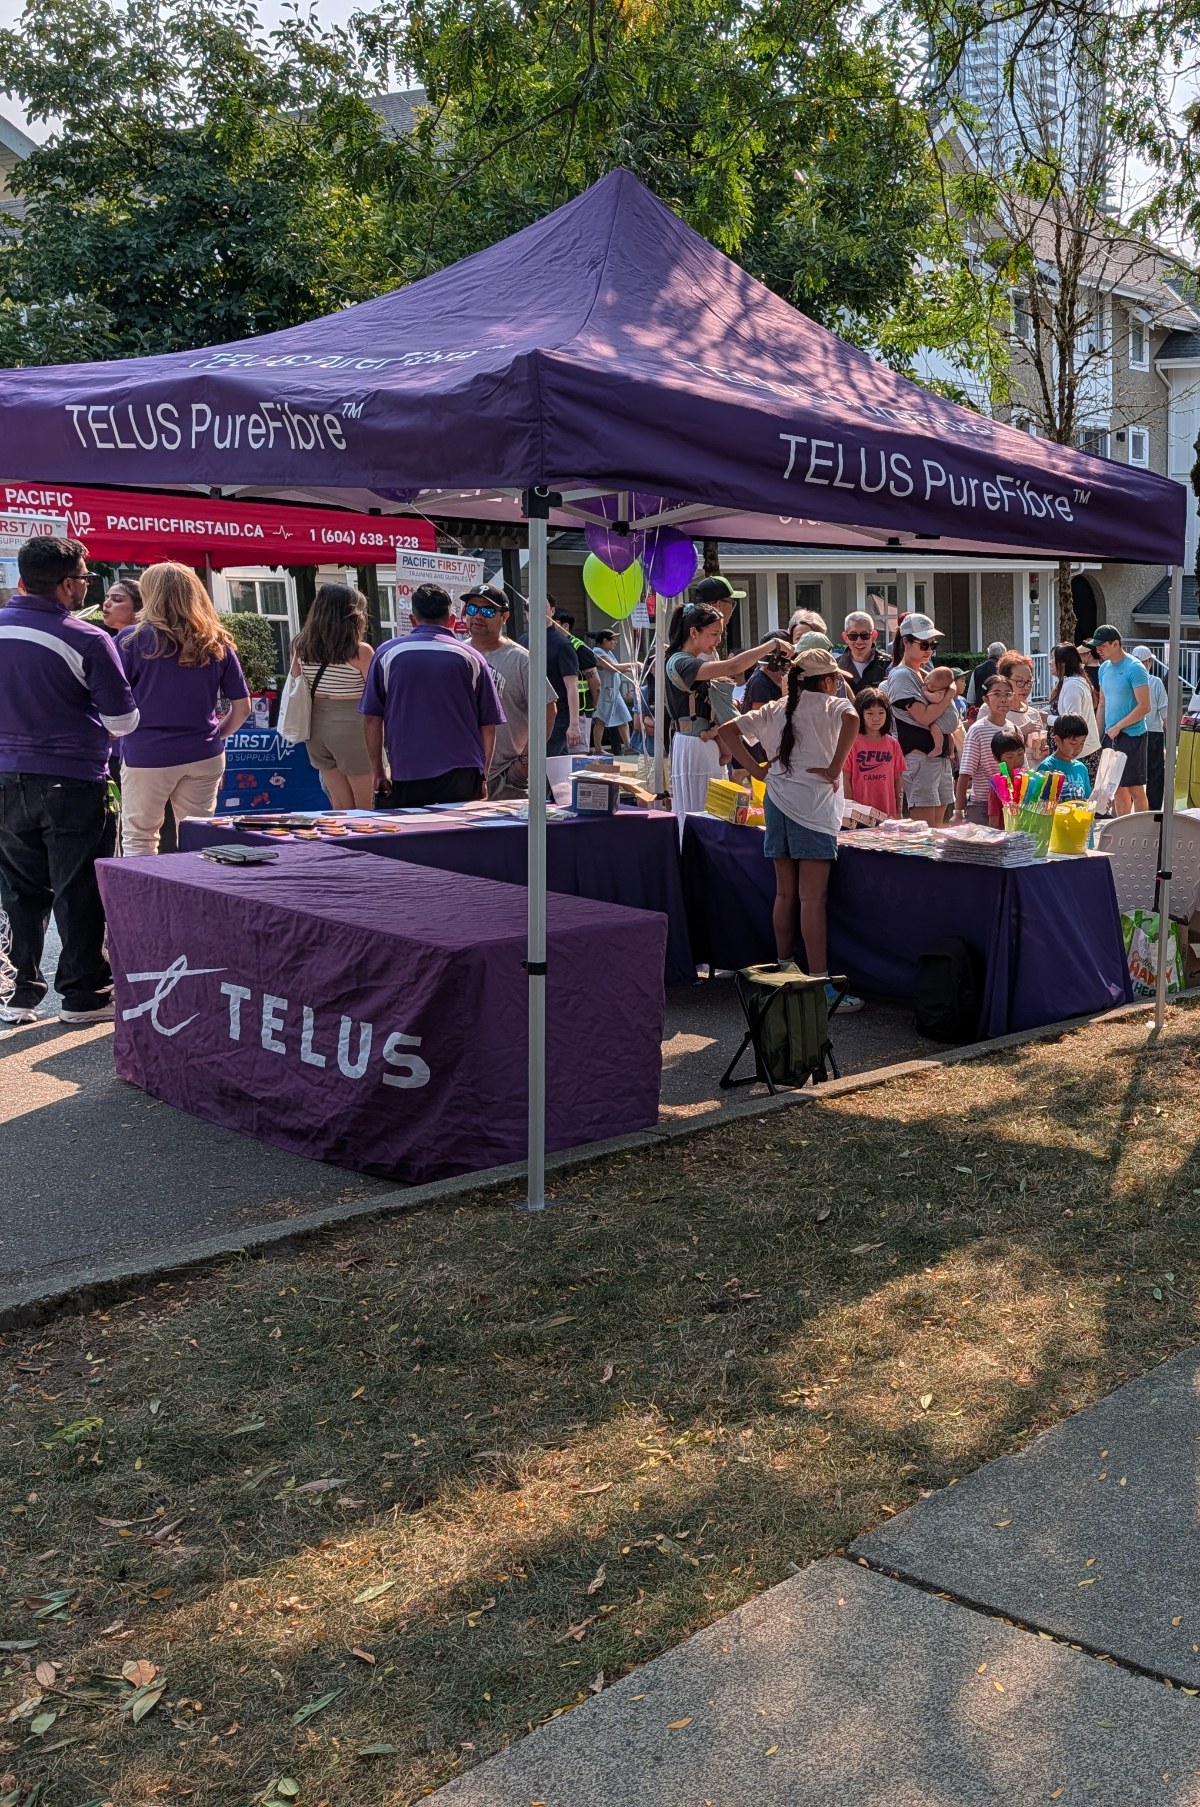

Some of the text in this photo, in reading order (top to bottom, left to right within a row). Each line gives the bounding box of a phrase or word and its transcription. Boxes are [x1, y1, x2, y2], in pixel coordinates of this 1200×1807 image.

[64, 402, 182, 450] TELUS
[779, 433, 914, 497] TELUS
[5, 488, 73, 507] PACIFIC
[0, 520, 27, 533] RST
[107, 516, 264, 539] PACIFICFIRSTAID.CA
[309, 527, 419, 549] 1 (604) 638-1228
[402, 555, 436, 569] PACIFIC
[437, 560, 461, 572] FIRST
[409, 570, 433, 579] TRAINING
[225, 734, 271, 749] FIRST
[235, 753, 276, 762] SUPPLIES
[856, 750, 887, 763] SFU
[1129, 961, 1173, 986] HAPY
[220, 982, 430, 1088] TELUS
